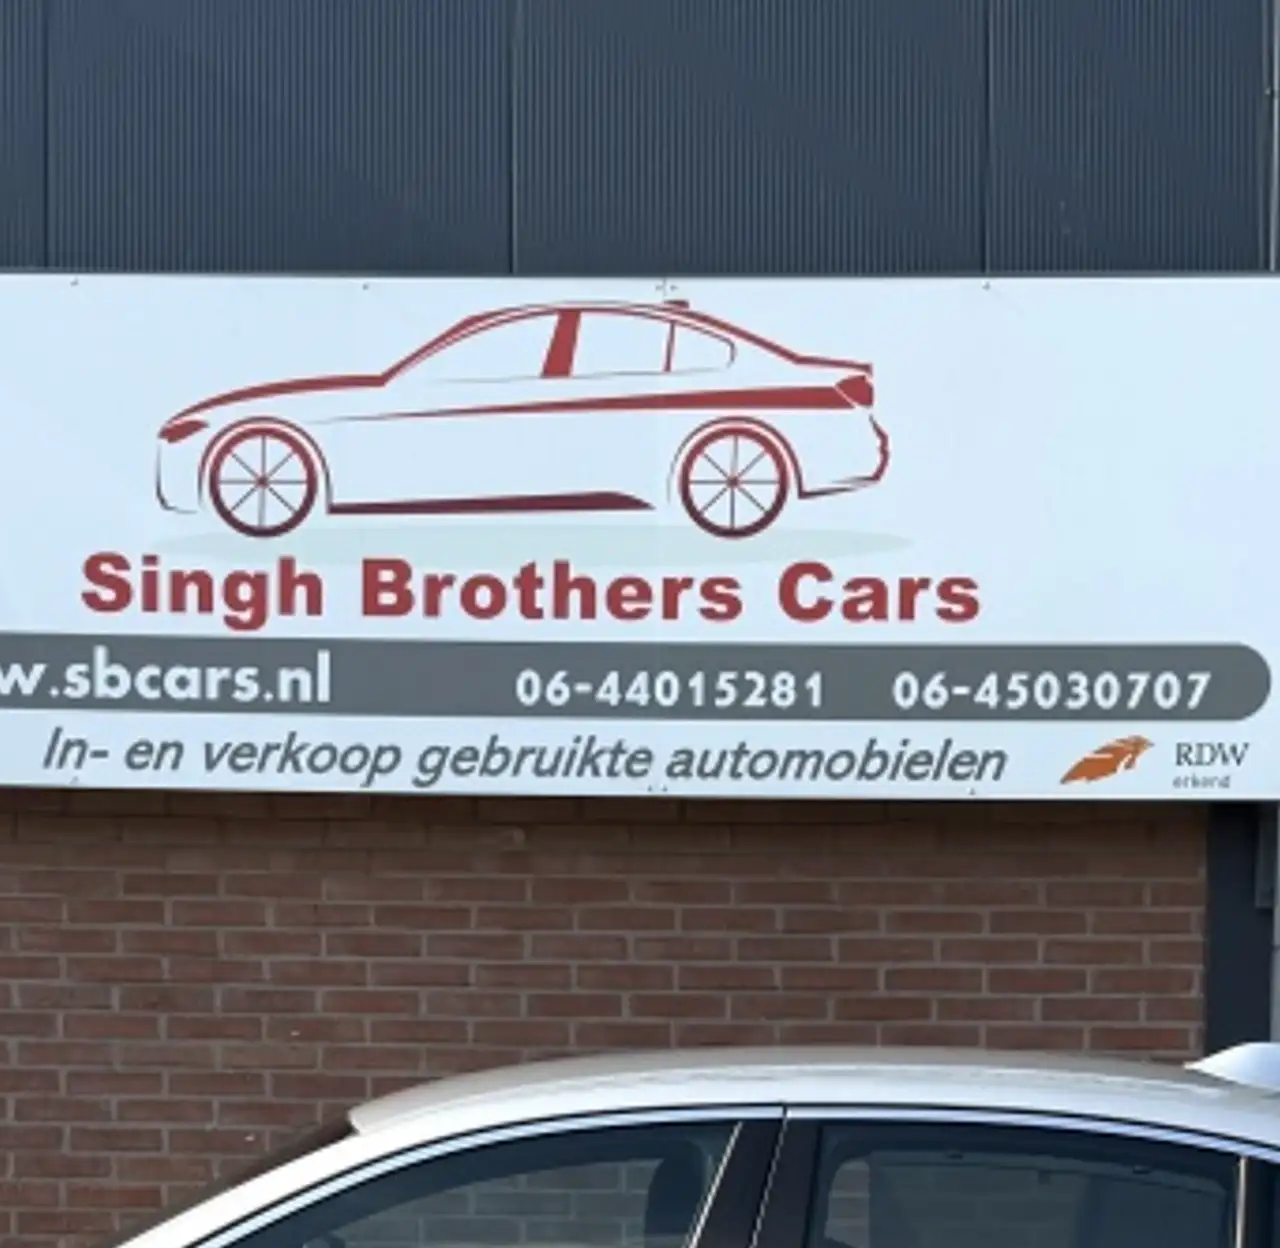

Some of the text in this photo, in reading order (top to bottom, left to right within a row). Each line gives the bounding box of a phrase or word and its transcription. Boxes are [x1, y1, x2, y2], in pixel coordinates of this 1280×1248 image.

[80, 551, 982, 632] Singh Brothers Cars
[515, 668, 823, 709] 06-44015281
[892, 671, 1211, 710] 06-45030707
[43, 726, 1008, 788] In- en verkoop gebruikte automobielen
[1175, 741, 1250, 767] RDW
